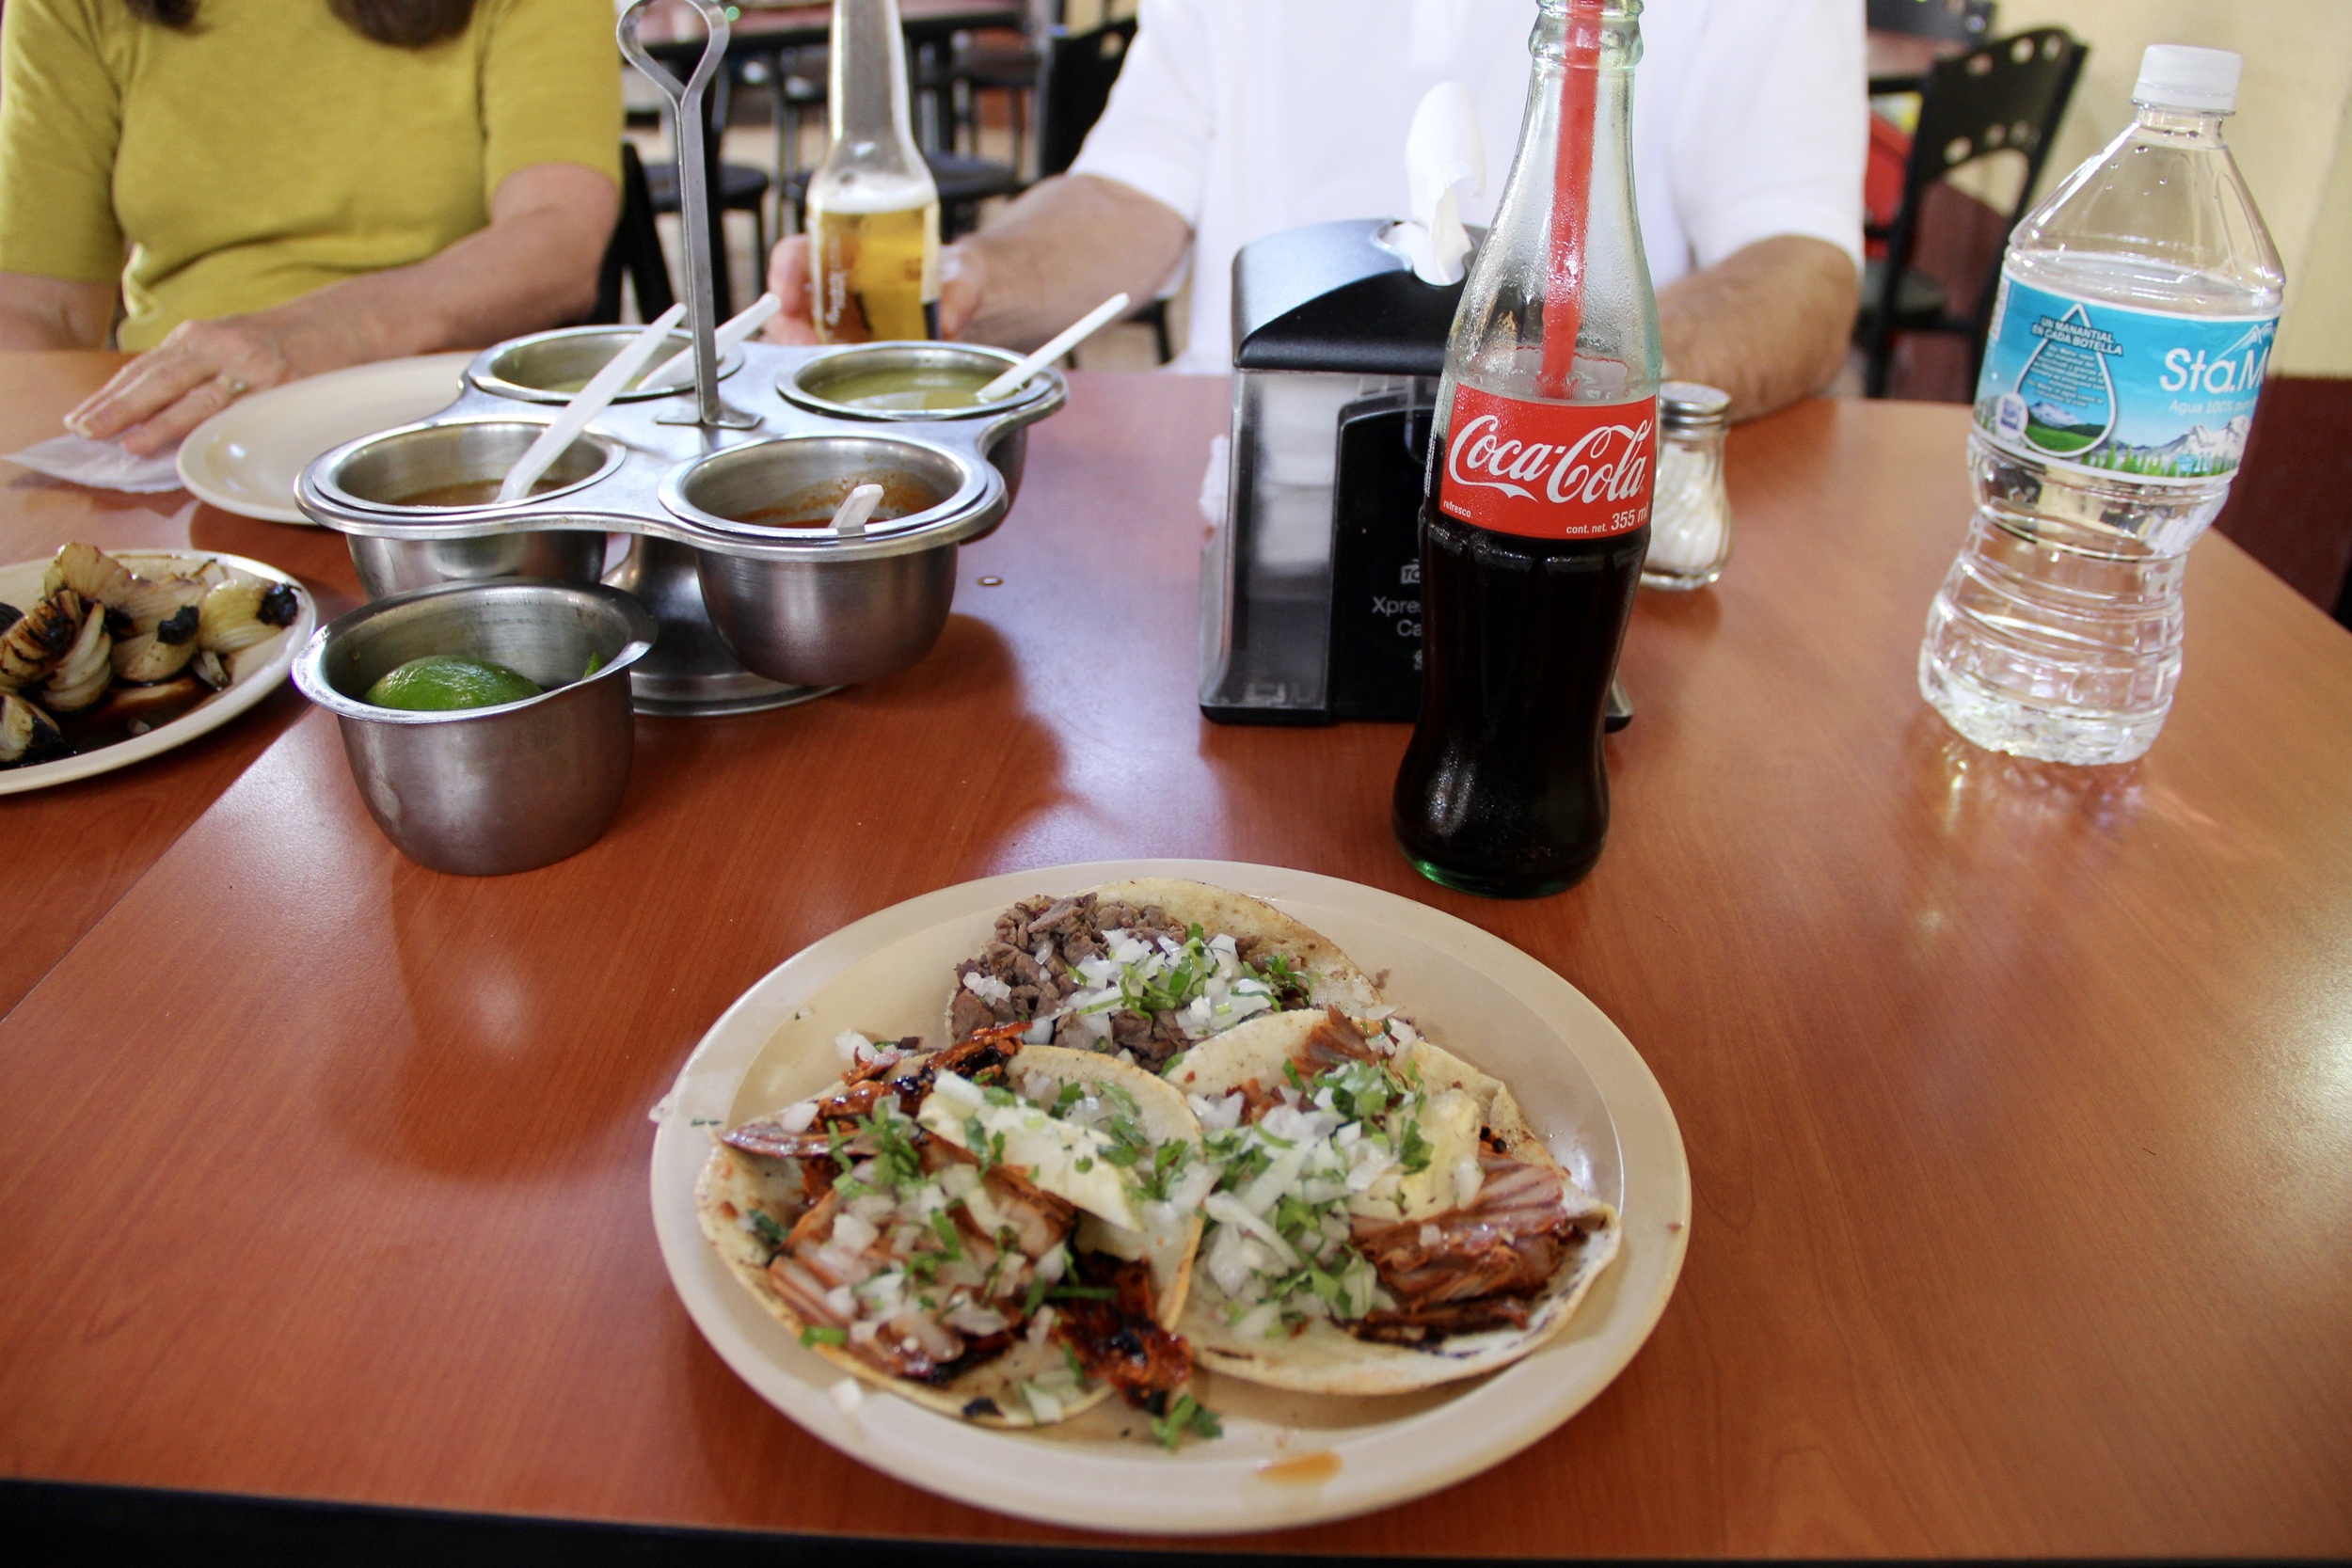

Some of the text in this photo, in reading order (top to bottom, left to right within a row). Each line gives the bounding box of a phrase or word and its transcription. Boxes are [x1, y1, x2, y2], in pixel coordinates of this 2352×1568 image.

[2032, 324, 2044, 336] EN
[2044, 327, 2072, 344] CADA
[2072, 335, 2122, 356] BOTELLA
[2040, 317, 2114, 344] UN MANANTIAL
[2159, 346, 2270, 394] Sta.M
[1448, 414, 1654, 504] Coca-Cola
[1443, 499, 1471, 518] refresco
[1565, 524, 1589, 534] cont.
[1591, 523, 1607, 533] net.
[1610, 509, 1635, 531] 355
